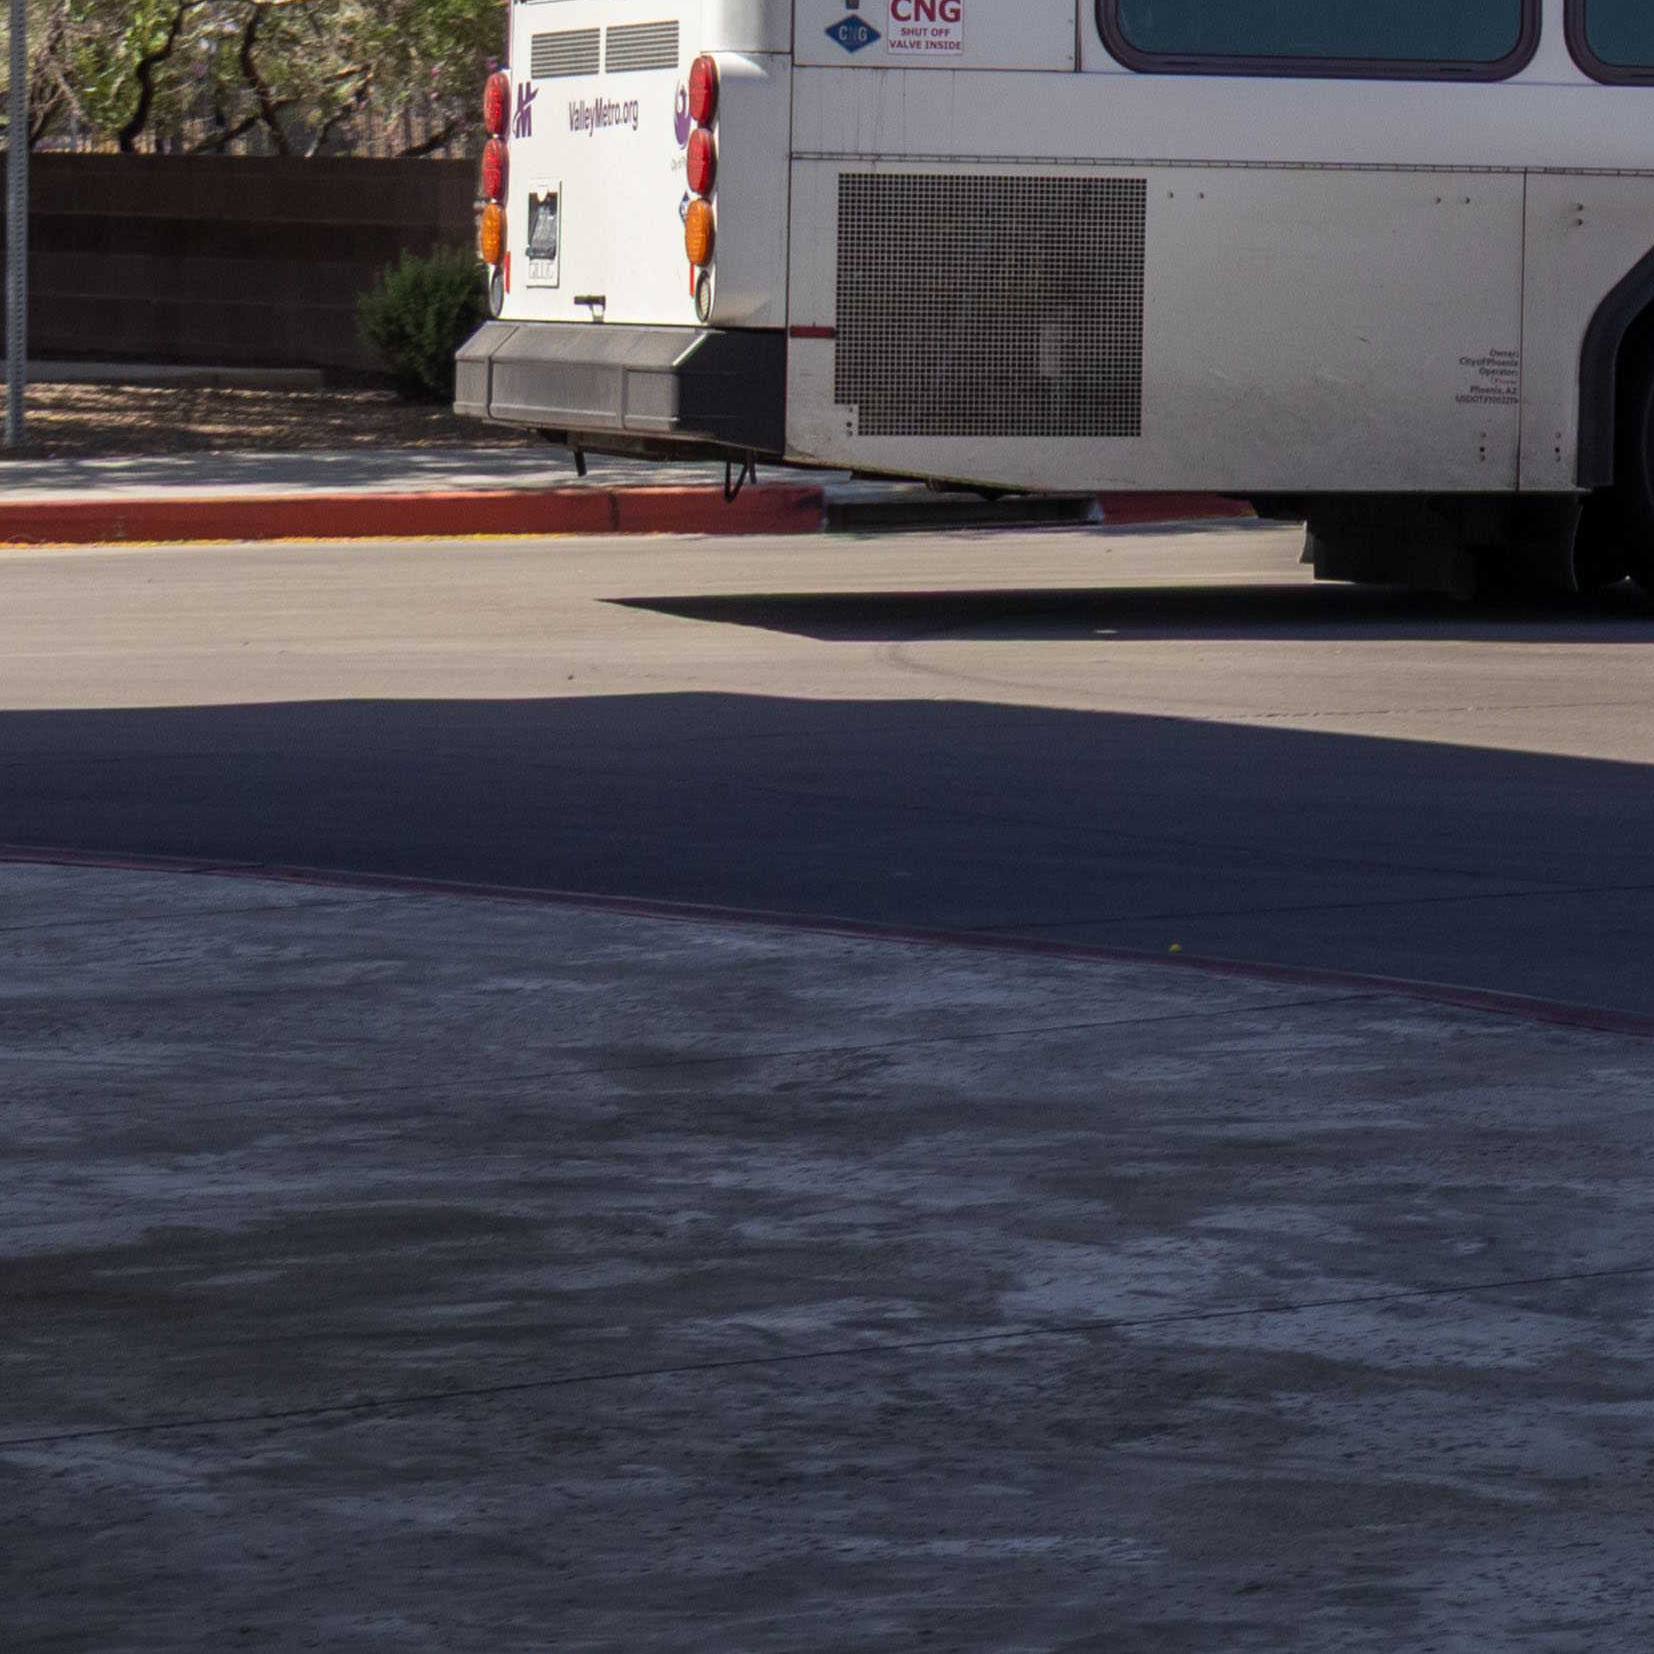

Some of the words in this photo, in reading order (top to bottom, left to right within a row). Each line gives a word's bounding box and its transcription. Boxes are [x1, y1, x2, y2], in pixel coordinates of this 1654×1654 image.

[838, 25, 868, 41] CNG
[901, 27, 928, 37] SHUT
[931, 28, 951, 37] OFF
[889, 40, 923, 49] VALVE
[924, 40, 962, 51] INSIDE
[568, 97, 639, 137] ValleyMetro.org
